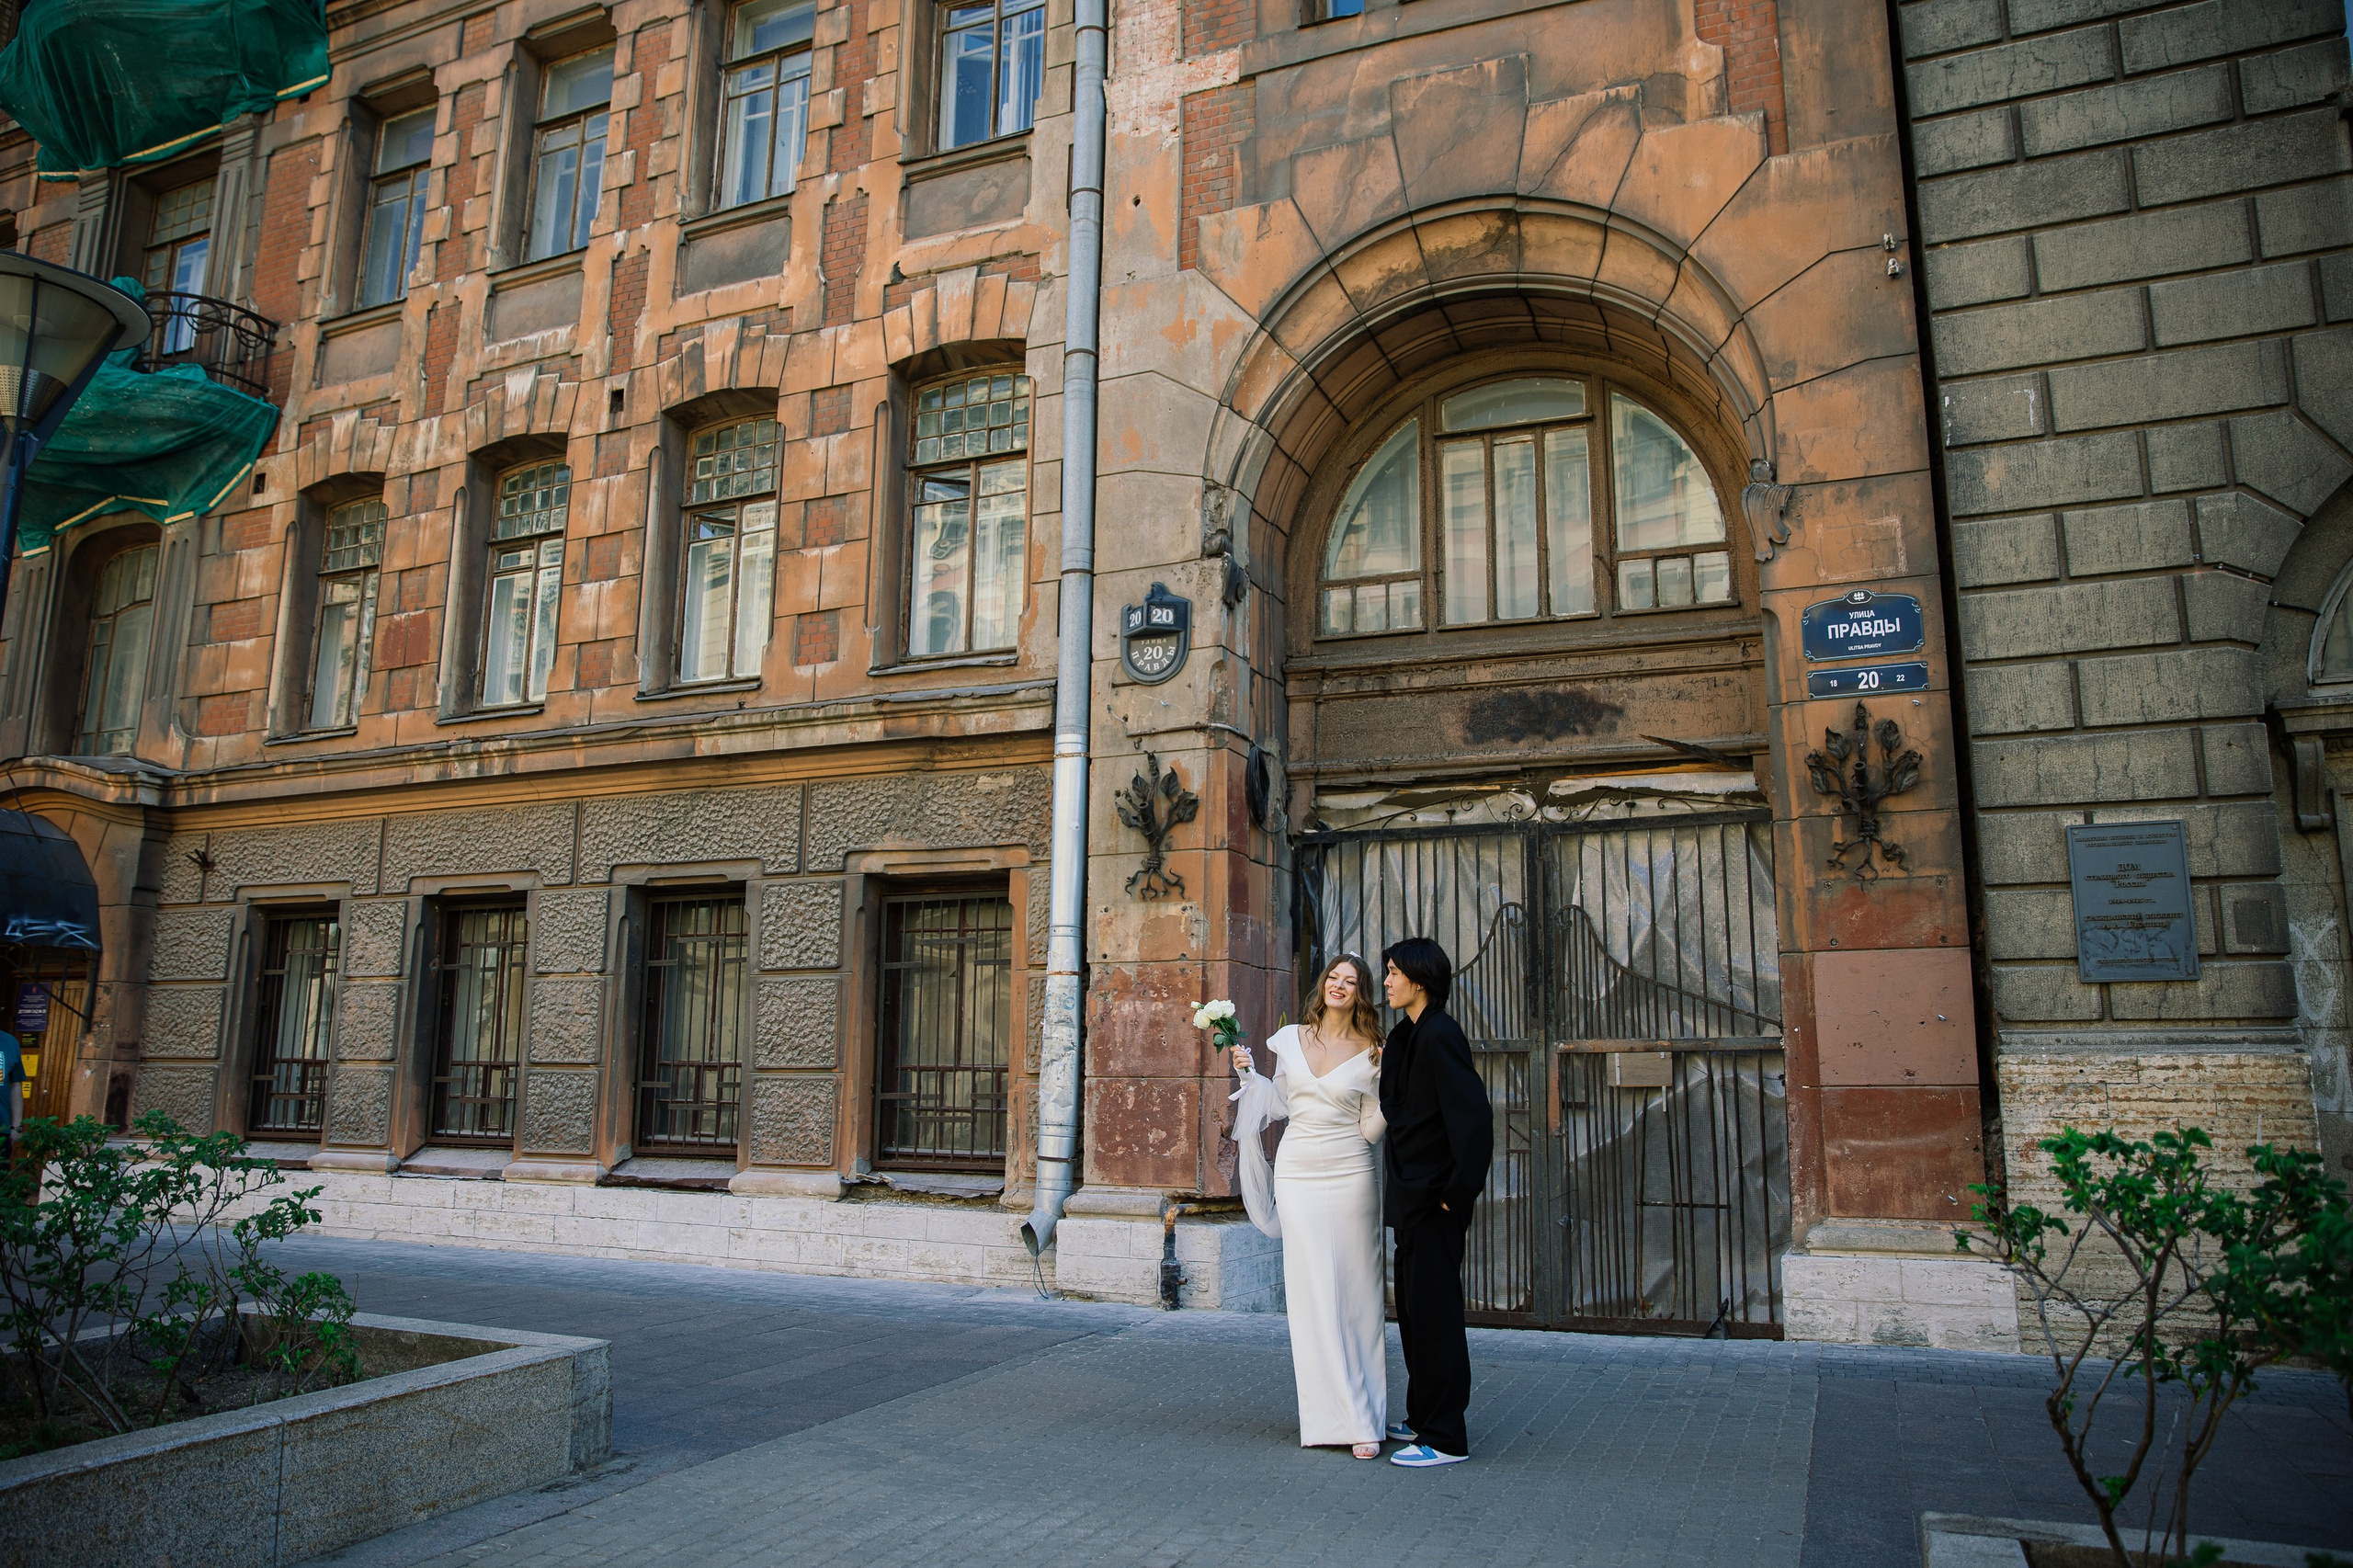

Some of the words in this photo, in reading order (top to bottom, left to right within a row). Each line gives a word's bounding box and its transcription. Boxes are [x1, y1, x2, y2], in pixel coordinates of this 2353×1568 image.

[1129, 610, 1142, 627] 20
[1152, 608, 1174, 623] 20
[1848, 609, 1875, 619] УЛИЦА
[1827, 618, 1901, 640] ПРАВДЫ
[1131, 646, 1176, 671] ПРАВДЫ
[1143, 645, 1164, 660] 20
[1830, 679, 1837, 687] 18
[1858, 671, 1879, 689] 20
[1896, 674, 1905, 682] 22
[2118, 863, 2141, 872] ДОМ
